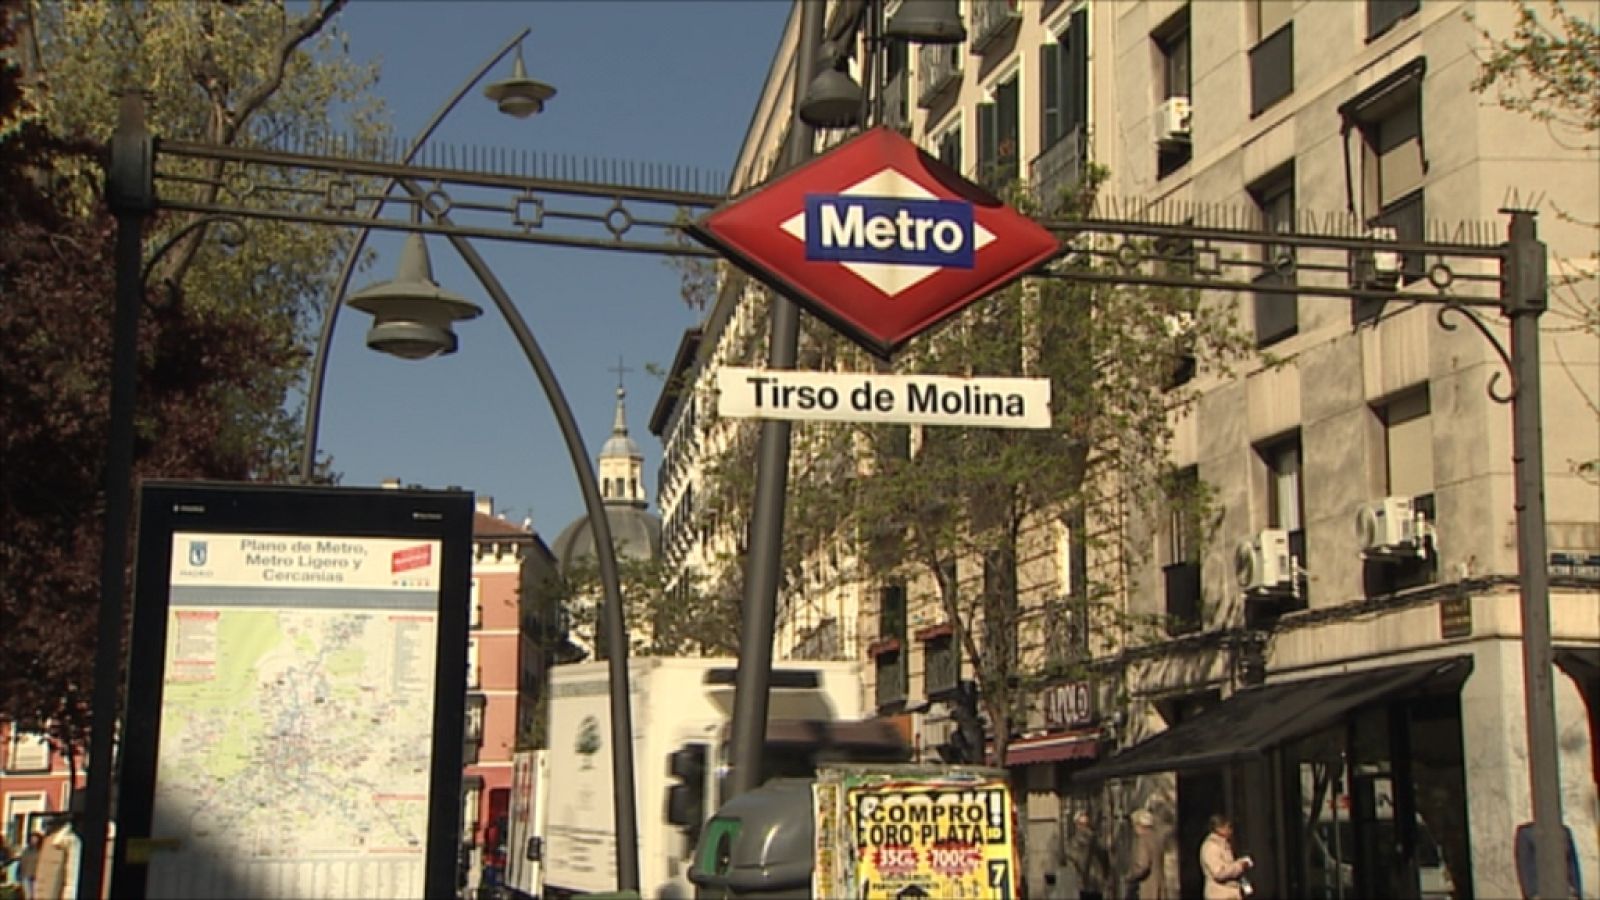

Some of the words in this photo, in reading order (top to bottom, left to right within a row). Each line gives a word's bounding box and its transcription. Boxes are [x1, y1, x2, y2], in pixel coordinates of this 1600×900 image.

[820, 203, 965, 253] Metro
[746, 377, 839, 411] Tirso
[850, 381, 895, 413] de
[907, 383, 1026, 418] Molina
[240, 538, 287, 553] Plano
[290, 540, 312, 553] de
[316, 541, 368, 556] Metro,
[245, 554, 294, 567] Metro
[297, 555, 350, 569] Ligero
[352, 558, 363, 571] y
[869, 803, 984, 823] COMPRO
[991, 863, 1005, 886] 7
